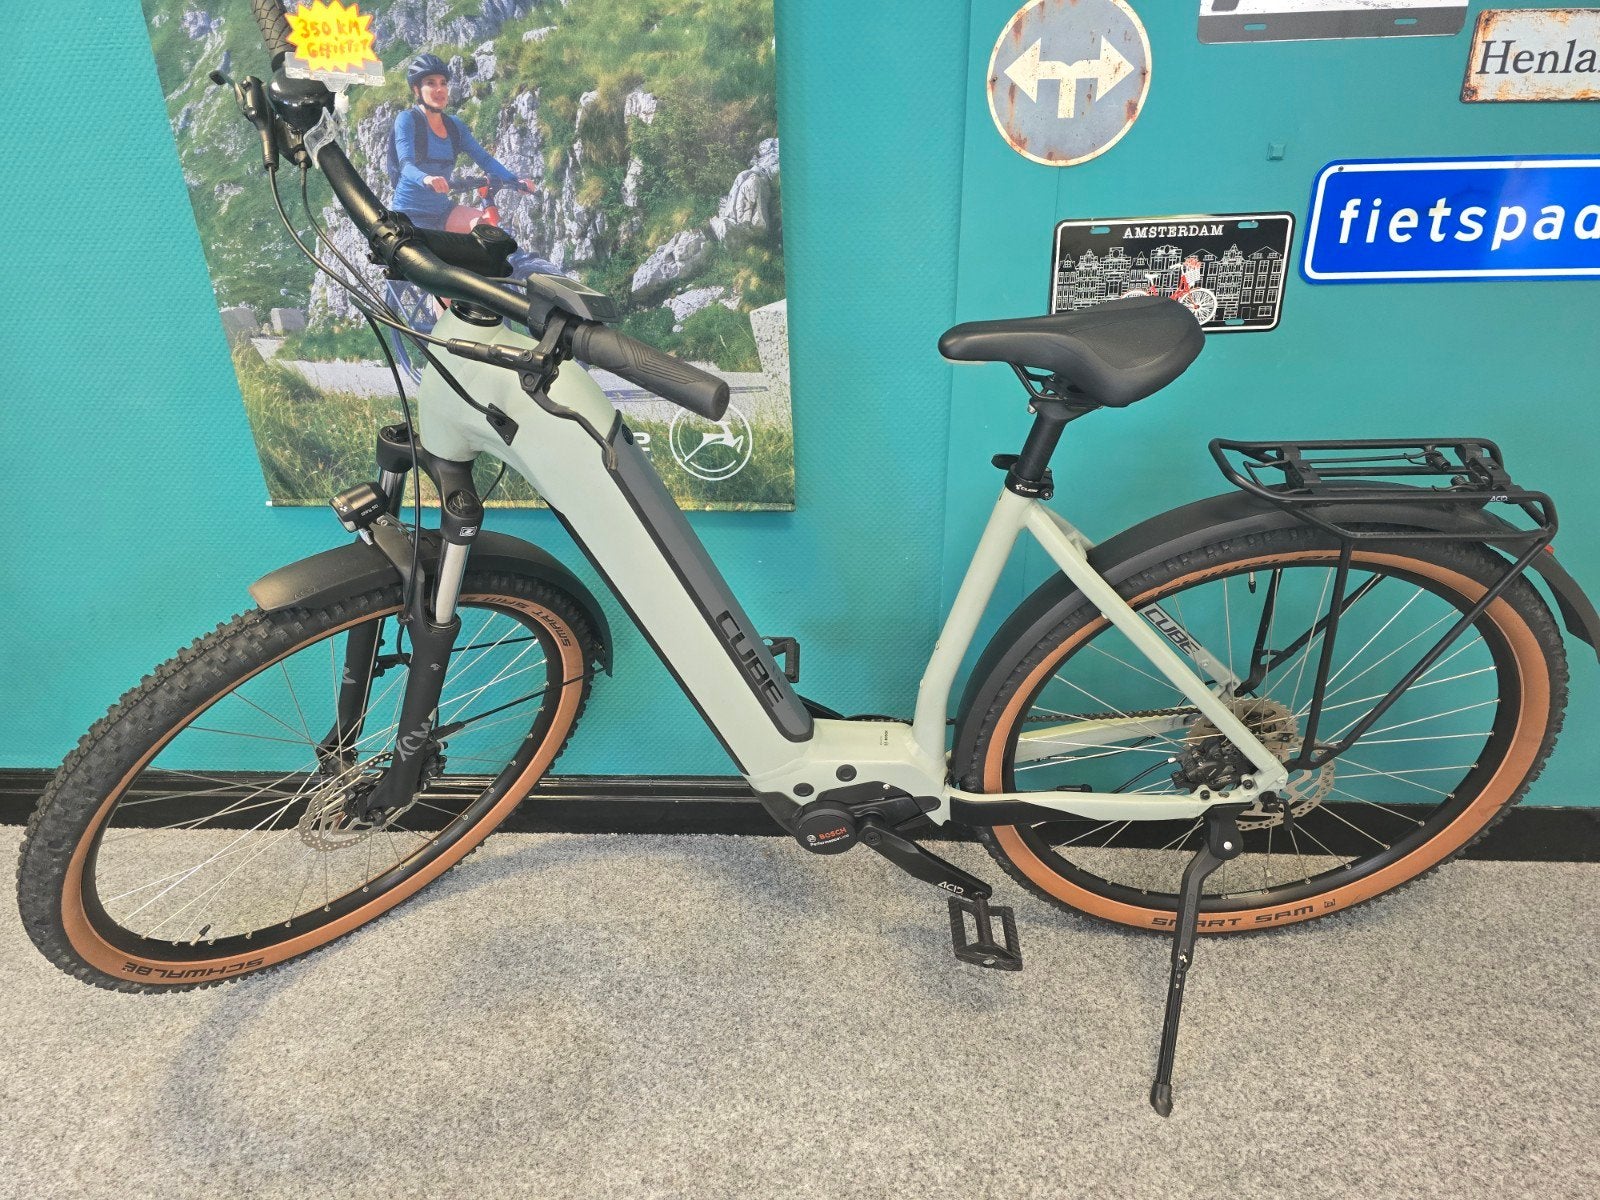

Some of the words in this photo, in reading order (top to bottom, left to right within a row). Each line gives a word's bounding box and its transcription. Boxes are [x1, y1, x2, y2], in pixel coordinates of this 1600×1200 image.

[299, 18, 332, 39] 350
[1475, 38, 1600, 75] Henla
[1122, 224, 1225, 240] AMSTERDAM
[1338, 197, 1600, 252] fietspad
[1144, 608, 1201, 656] CUBE
[715, 610, 784, 708] CUBE
[818, 827, 848, 840] BOSCH
[937, 881, 965, 895] ACID
[1254, 905, 1314, 924] SAM
[121, 956, 265, 979] SCHWALBE
